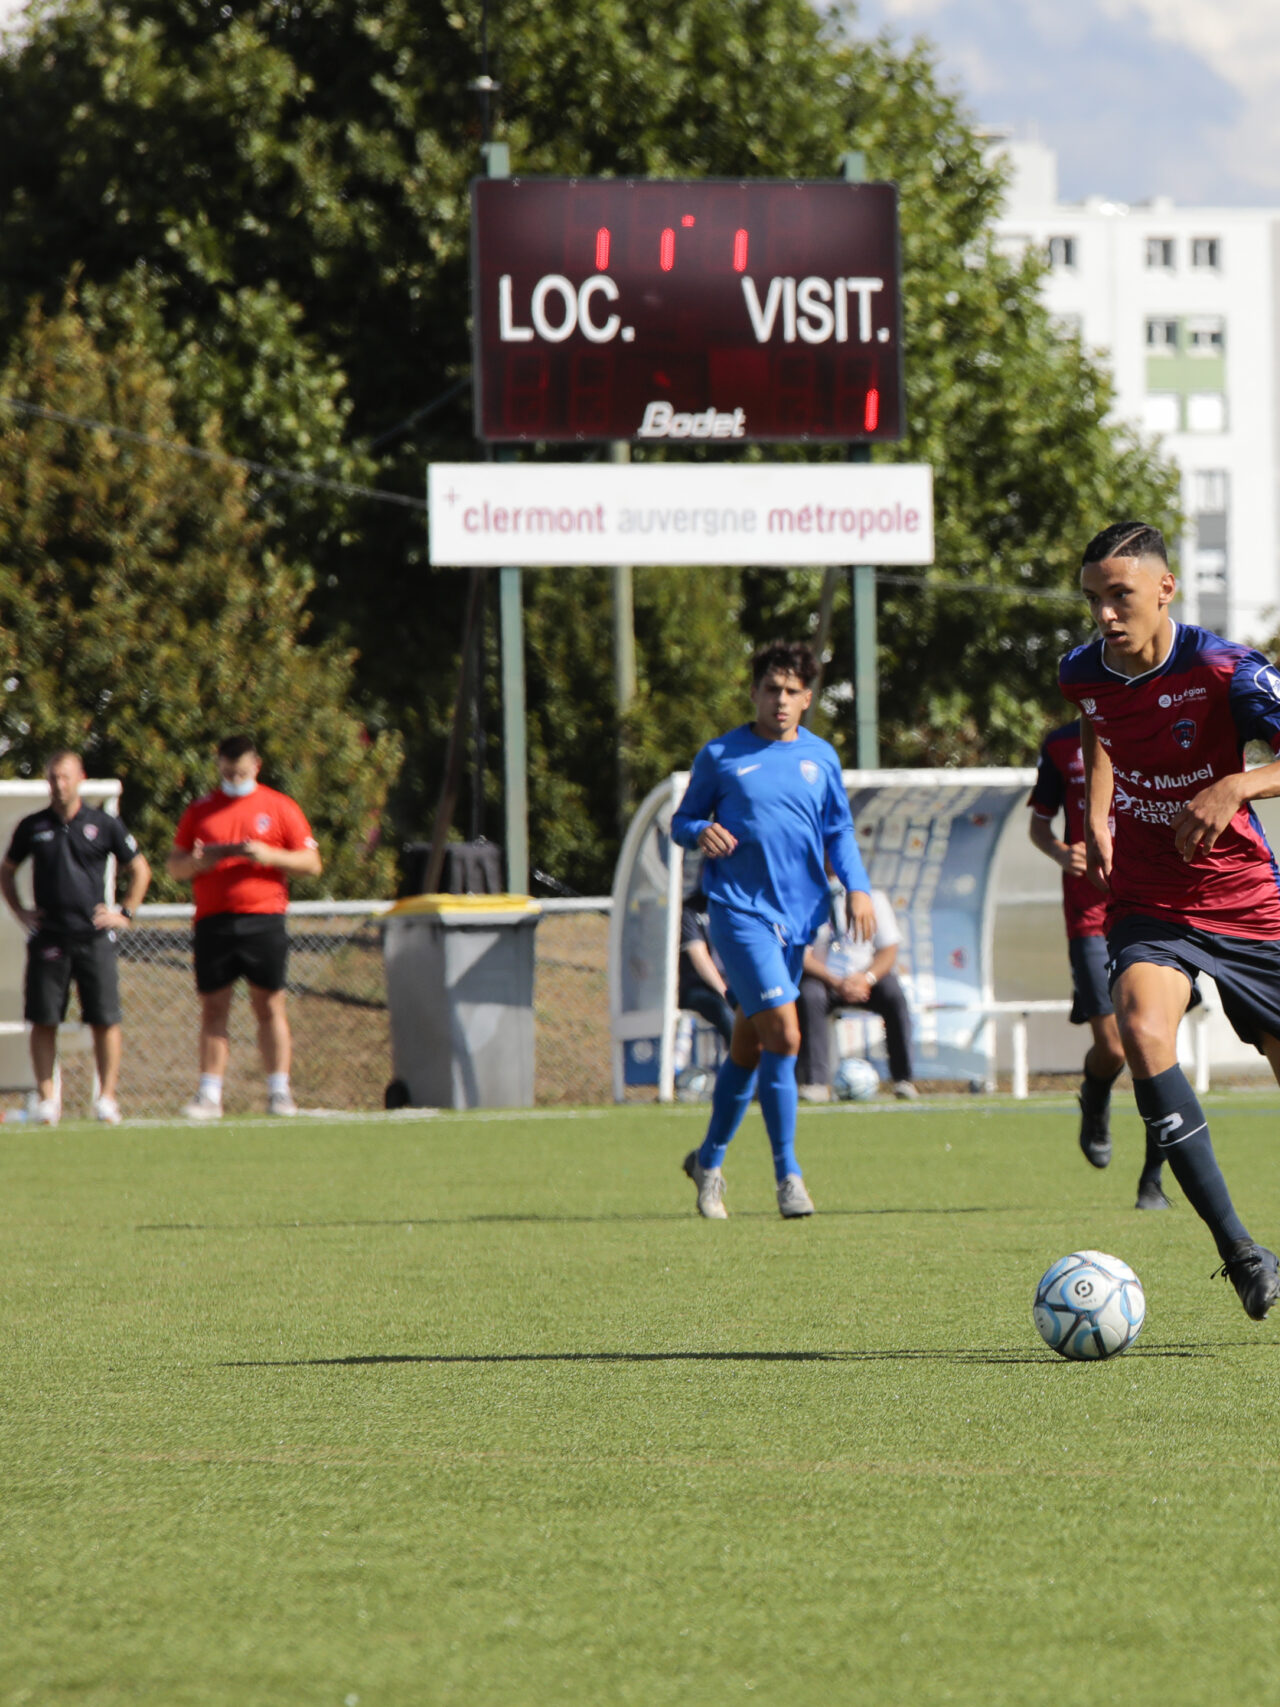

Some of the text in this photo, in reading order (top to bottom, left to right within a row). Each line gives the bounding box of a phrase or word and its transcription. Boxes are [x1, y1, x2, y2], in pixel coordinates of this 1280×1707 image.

[499, 274, 636, 343] LOC.
[741, 276, 890, 344] VISIT.
[638, 400, 746, 438] Bodet
[463, 500, 919, 540] clermont auvergne métropole
[1153, 763, 1214, 790] Mutuel
